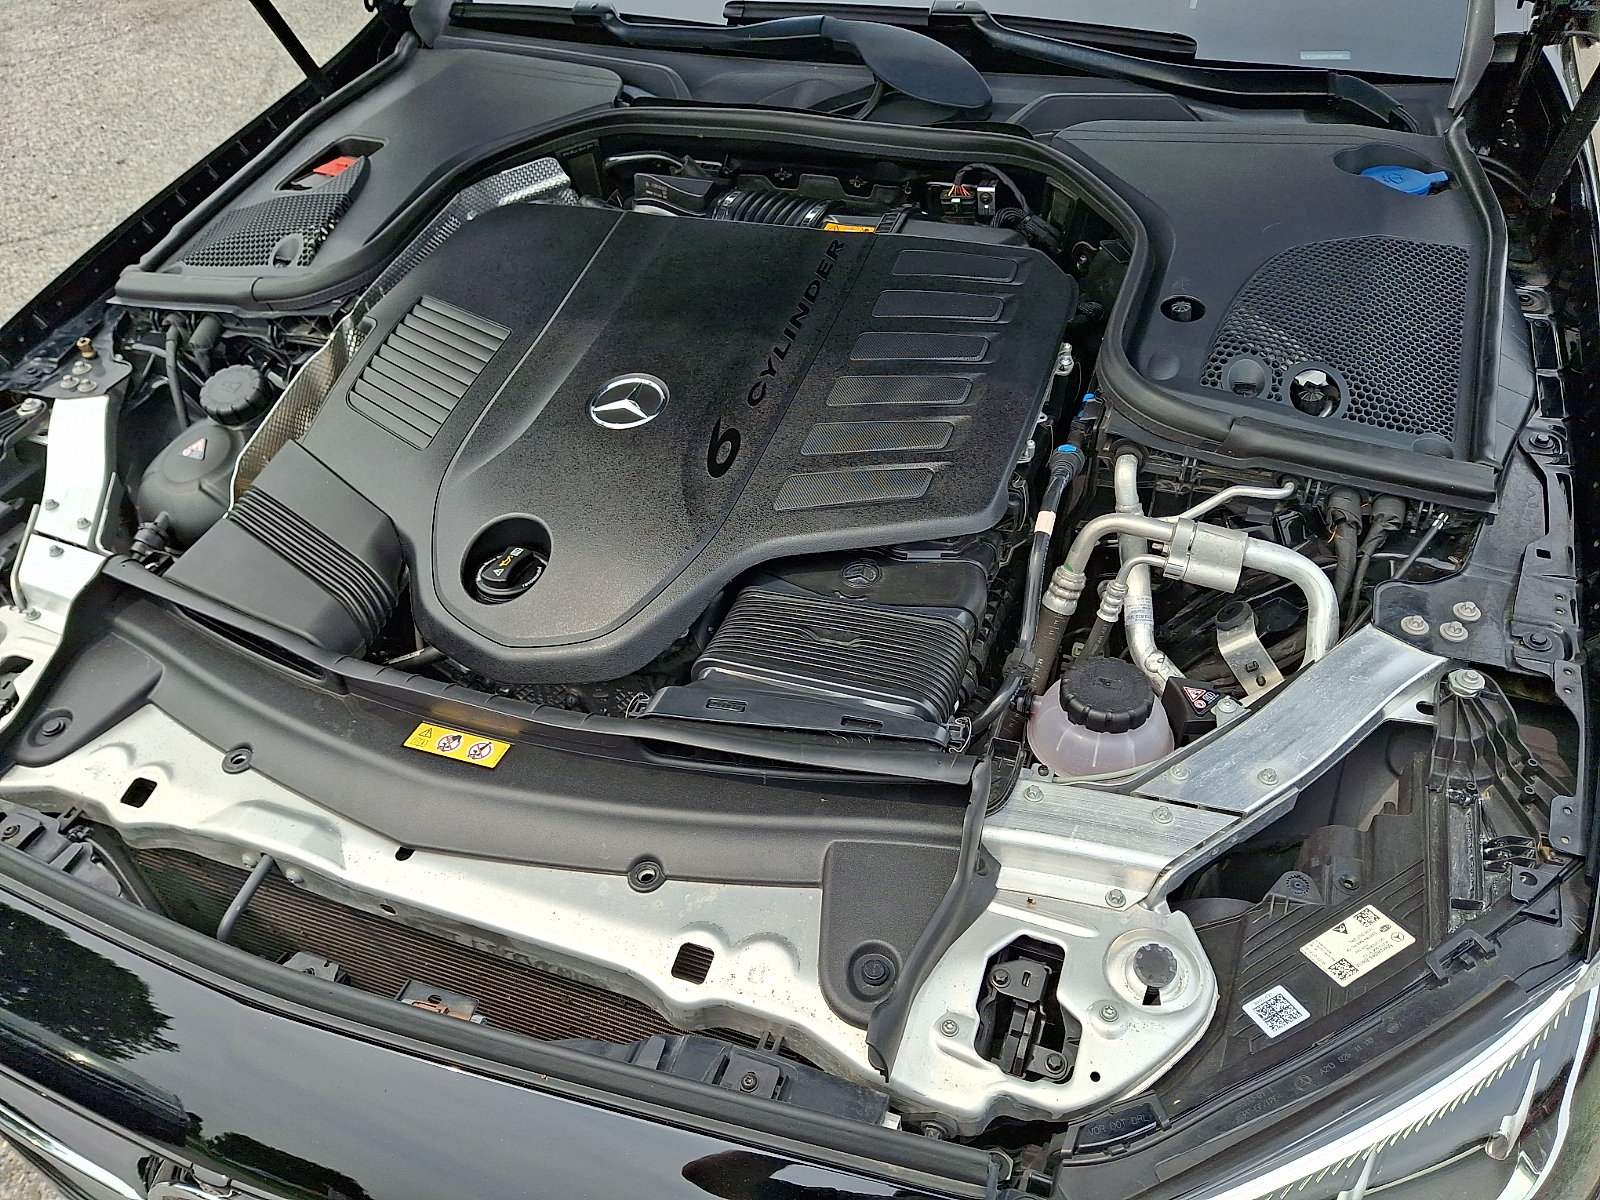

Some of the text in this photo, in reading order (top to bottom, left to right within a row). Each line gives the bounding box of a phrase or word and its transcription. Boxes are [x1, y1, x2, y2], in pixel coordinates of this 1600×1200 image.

[706, 238, 846, 479] 6 CYLINDER
[1087, 1114, 1150, 1137] VOR DOT DRL
